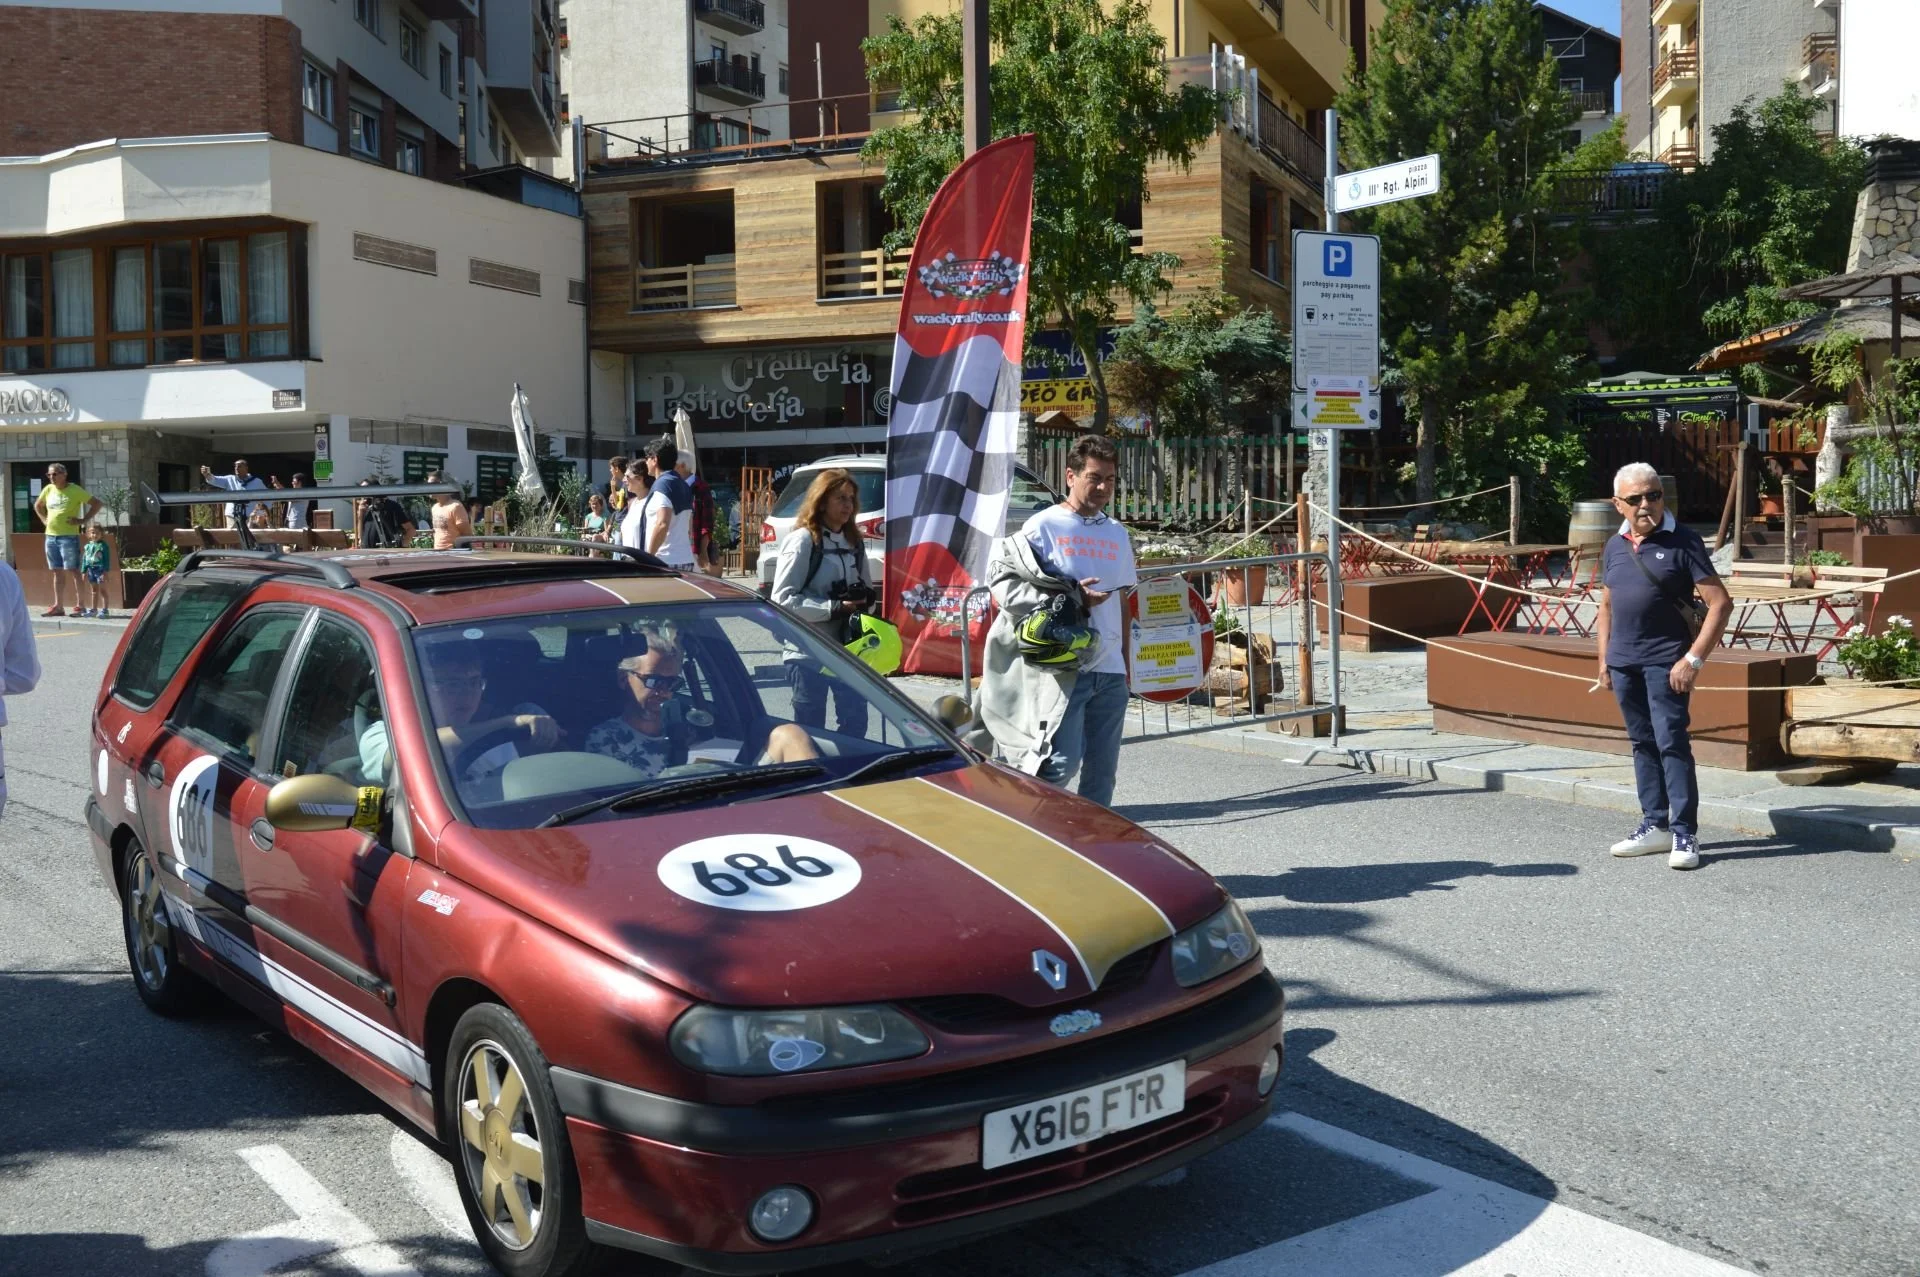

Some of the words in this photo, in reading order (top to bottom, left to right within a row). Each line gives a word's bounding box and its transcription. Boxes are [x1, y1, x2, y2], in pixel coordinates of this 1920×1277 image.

[1408, 163, 1428, 174] piazza
[1383, 181, 1400, 194] Rgt.
[1404, 173, 1428, 190] Alpini
[1329, 245, 1347, 272] P
[939, 270, 976, 286] Wacky
[977, 269, 1008, 283] Rally
[1302, 280, 1334, 289] parcheggio
[1340, 281, 1371, 290] pagamento
[1320, 291, 1331, 299] pay
[1332, 291, 1354, 300] parking
[913, 310, 1021, 325] wackyrally.co.uk
[721, 349, 872, 393] Cremeria
[647, 371, 805, 425] Pasticceria
[1056, 535, 1119, 551] NORTH
[1063, 546, 1117, 561] SAILS
[918, 597, 957, 610] Wacky
[691, 844, 834, 897] 686
[1009, 1095, 1091, 1154] X616
[1101, 1072, 1165, 1129] FTR
